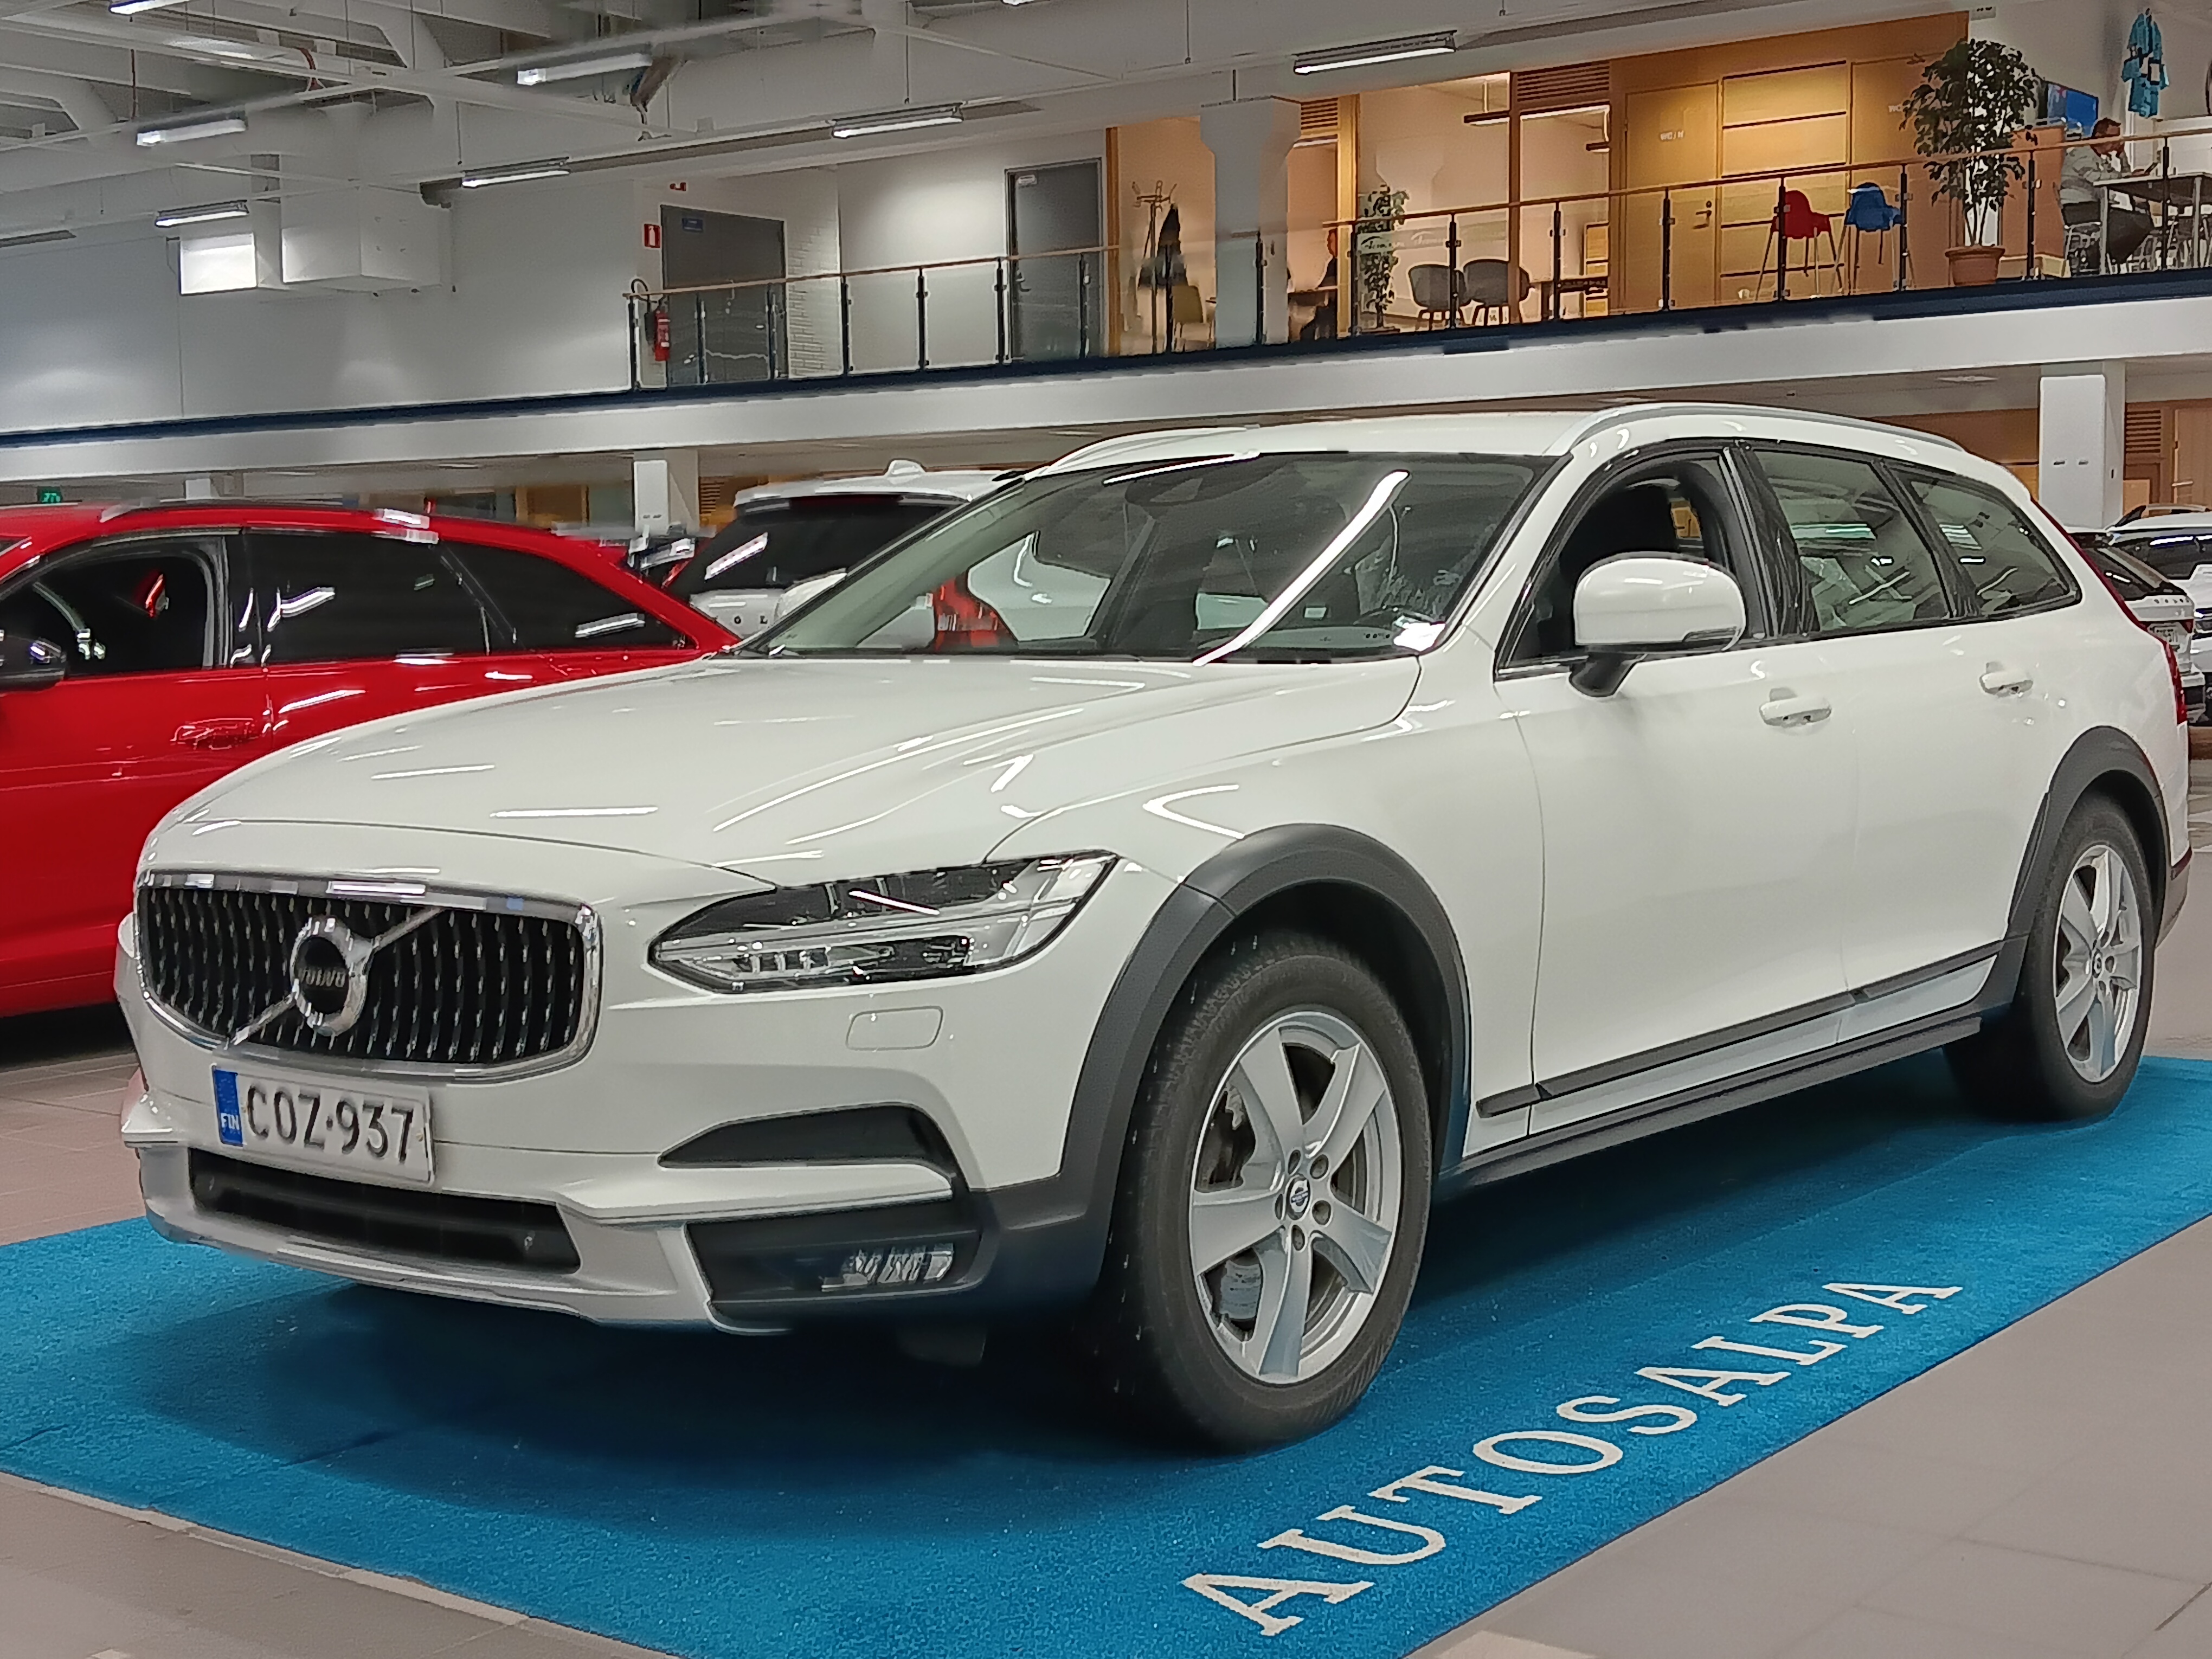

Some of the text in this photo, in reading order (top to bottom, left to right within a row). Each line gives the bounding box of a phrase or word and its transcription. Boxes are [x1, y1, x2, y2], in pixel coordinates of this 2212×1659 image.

[221, 1112, 240, 1131] FIN
[247, 1084, 414, 1165] COZ-937
[1181, 1282, 1963, 1636] AUTOSALPA
